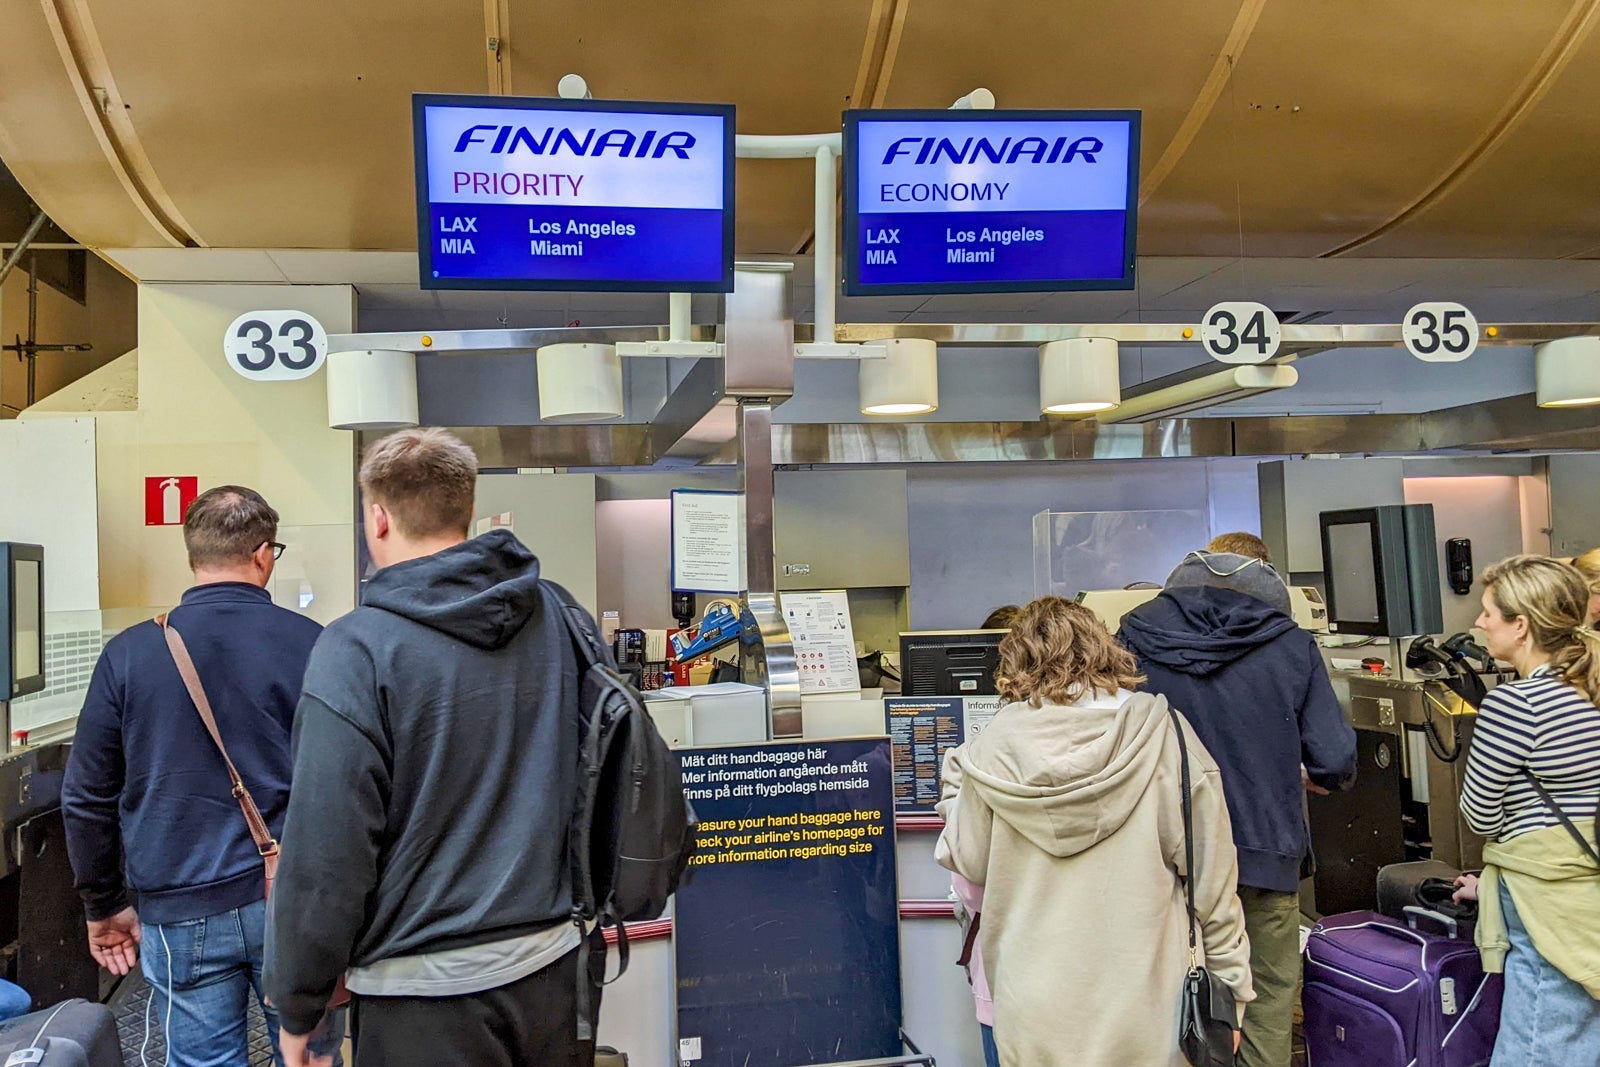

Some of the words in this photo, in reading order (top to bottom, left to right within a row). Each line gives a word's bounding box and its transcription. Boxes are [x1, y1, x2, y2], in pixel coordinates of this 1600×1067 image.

[454, 124, 696, 159] FINNAIR
[882, 136, 1104, 165] FINNAIR
[453, 171, 584, 197] PRIORITY
[880, 182, 1010, 202] ECONOMY
[440, 217, 478, 233] LAX
[529, 218, 562, 235] Los
[565, 219, 636, 239] Angeles
[866, 229, 900, 244] LAX
[946, 227, 976, 243] Los
[979, 227, 1045, 246] Angeles
[441, 238, 475, 254] MIA
[530, 240, 583, 256] Miami
[866, 250, 897, 265] MIA
[947, 248, 995, 263] Miami
[1208, 310, 1271, 356] 34
[1410, 310, 1470, 355] 35
[236, 318, 317, 371] 33
[681, 756, 705, 768] Mät
[707, 754, 728, 766] ditt
[730, 750, 805, 766] handbagage
[807, 748, 827, 760] här
[682, 771, 706, 784] Mer
[708, 767, 777, 782] information
[779, 764, 838, 779] angående
[840, 761, 868, 773] mått
[682, 788, 712, 800] finns
[715, 784, 730, 801] på
[732, 784, 753, 796] ditt
[755, 781, 817, 797] flygbolags
[819, 777, 869, 791] hemsida
[696, 819, 736, 832] easure
[738, 817, 765, 832] your
[767, 813, 798, 827] hand
[800, 811, 852, 826] baggage
[853, 809, 881, 821] here
[724, 835, 752, 848] your
[754, 830, 801, 844] airline's
[802, 825, 865, 841] homepage
[867, 824, 884, 836] for
[718, 846, 788, 863] information
[789, 842, 847, 859] regarding
[848, 841, 873, 853] size
